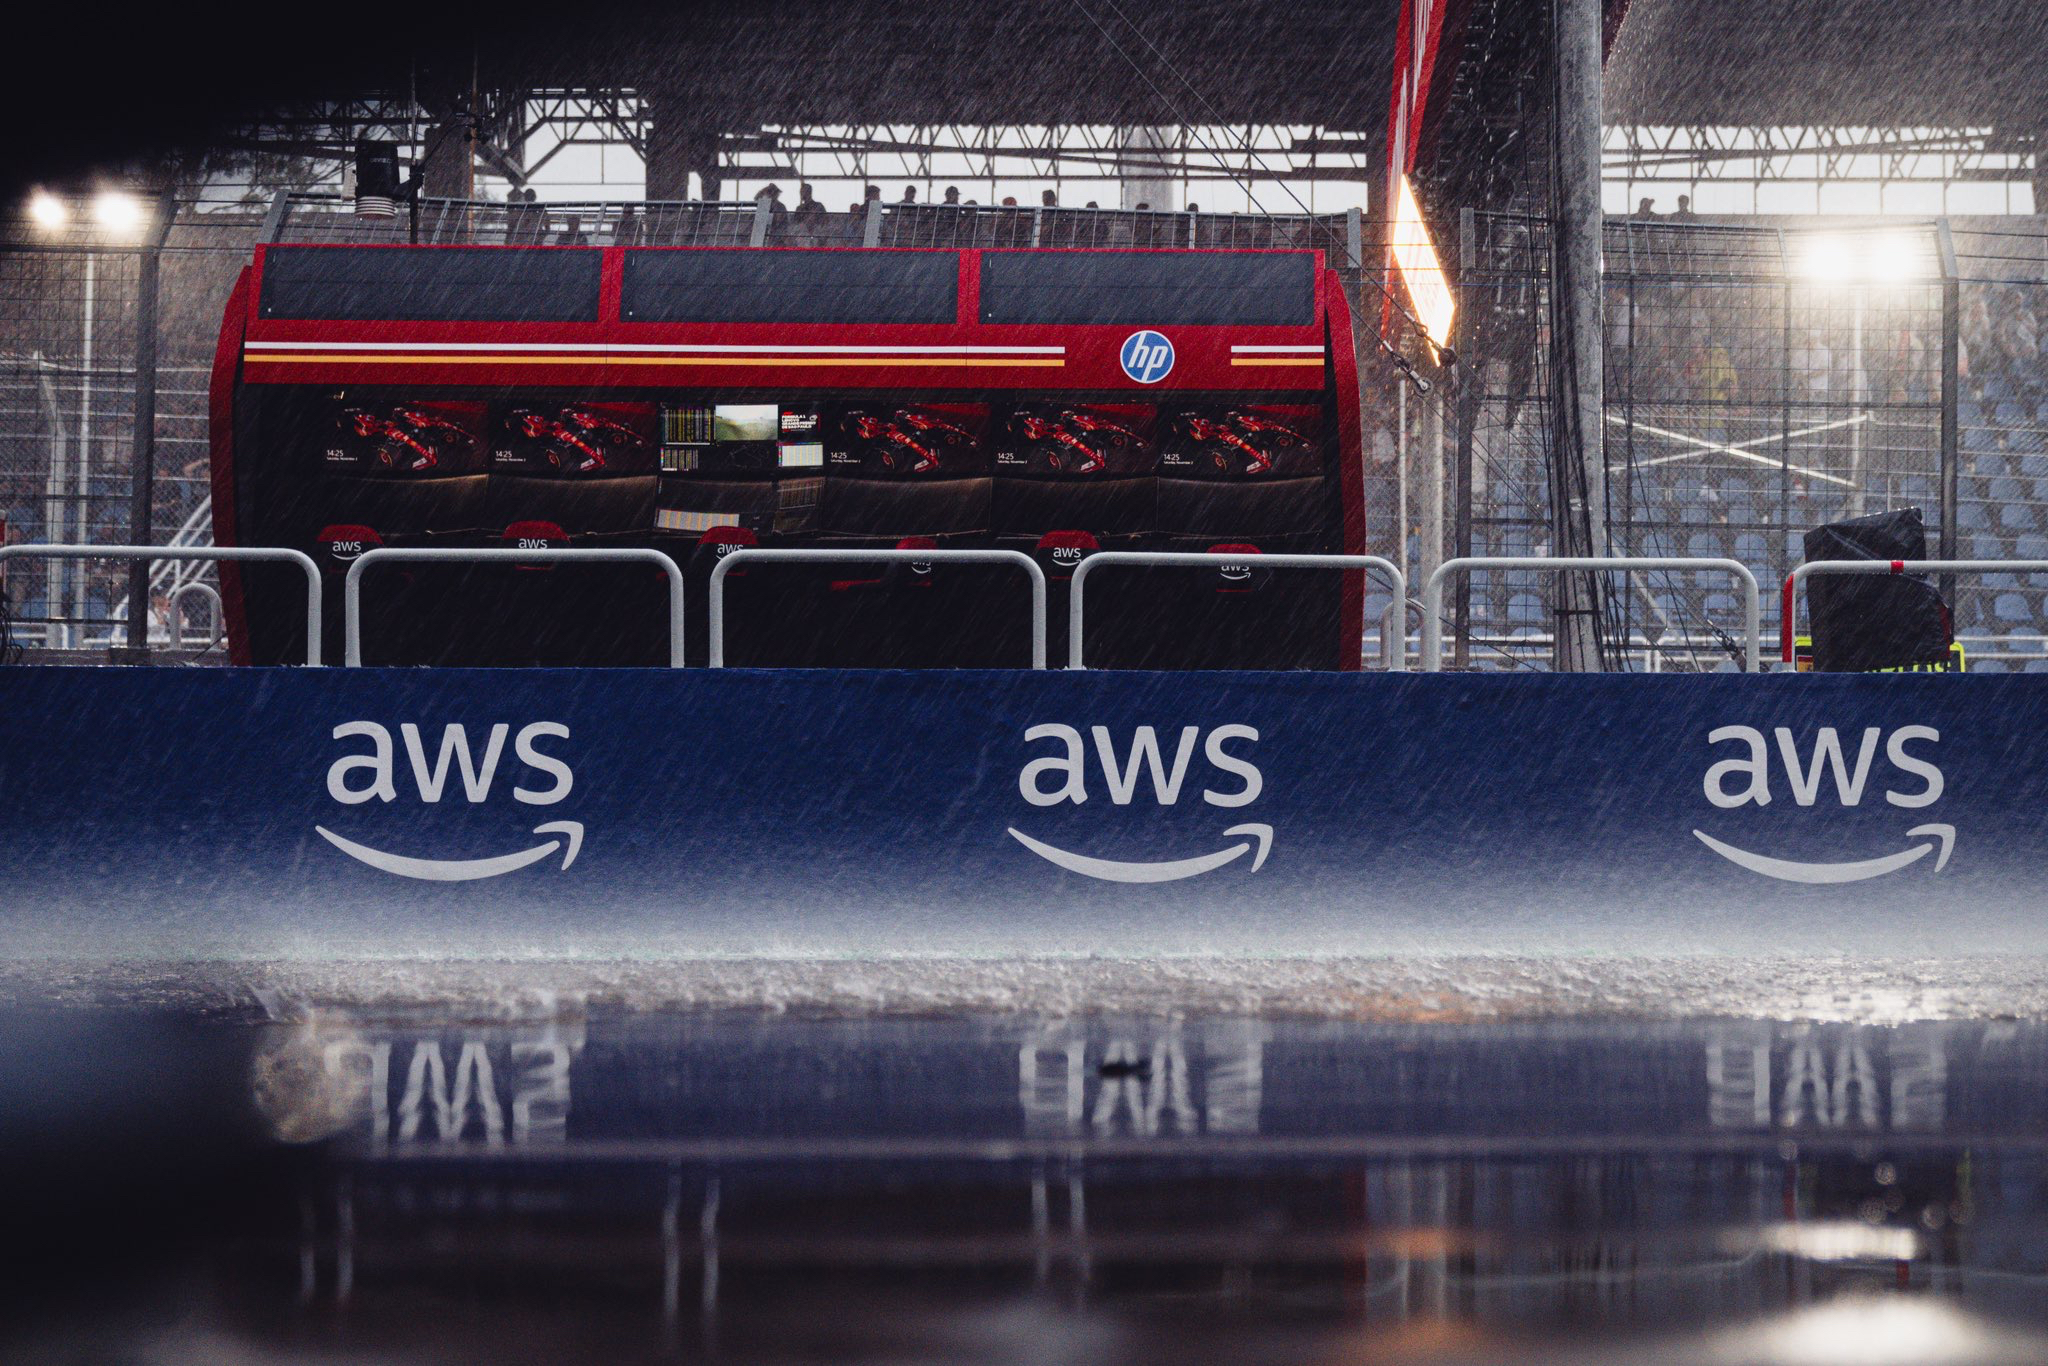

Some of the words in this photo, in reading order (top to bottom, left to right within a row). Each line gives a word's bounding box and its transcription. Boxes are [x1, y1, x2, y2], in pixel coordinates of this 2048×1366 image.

[1127, 332, 1168, 382] hp
[332, 541, 361, 552] aws
[518, 538, 548, 549] aws
[1053, 547, 1081, 558] aws
[328, 722, 574, 806] aws
[1019, 724, 1264, 809] aws
[1703, 726, 1946, 809] aws
